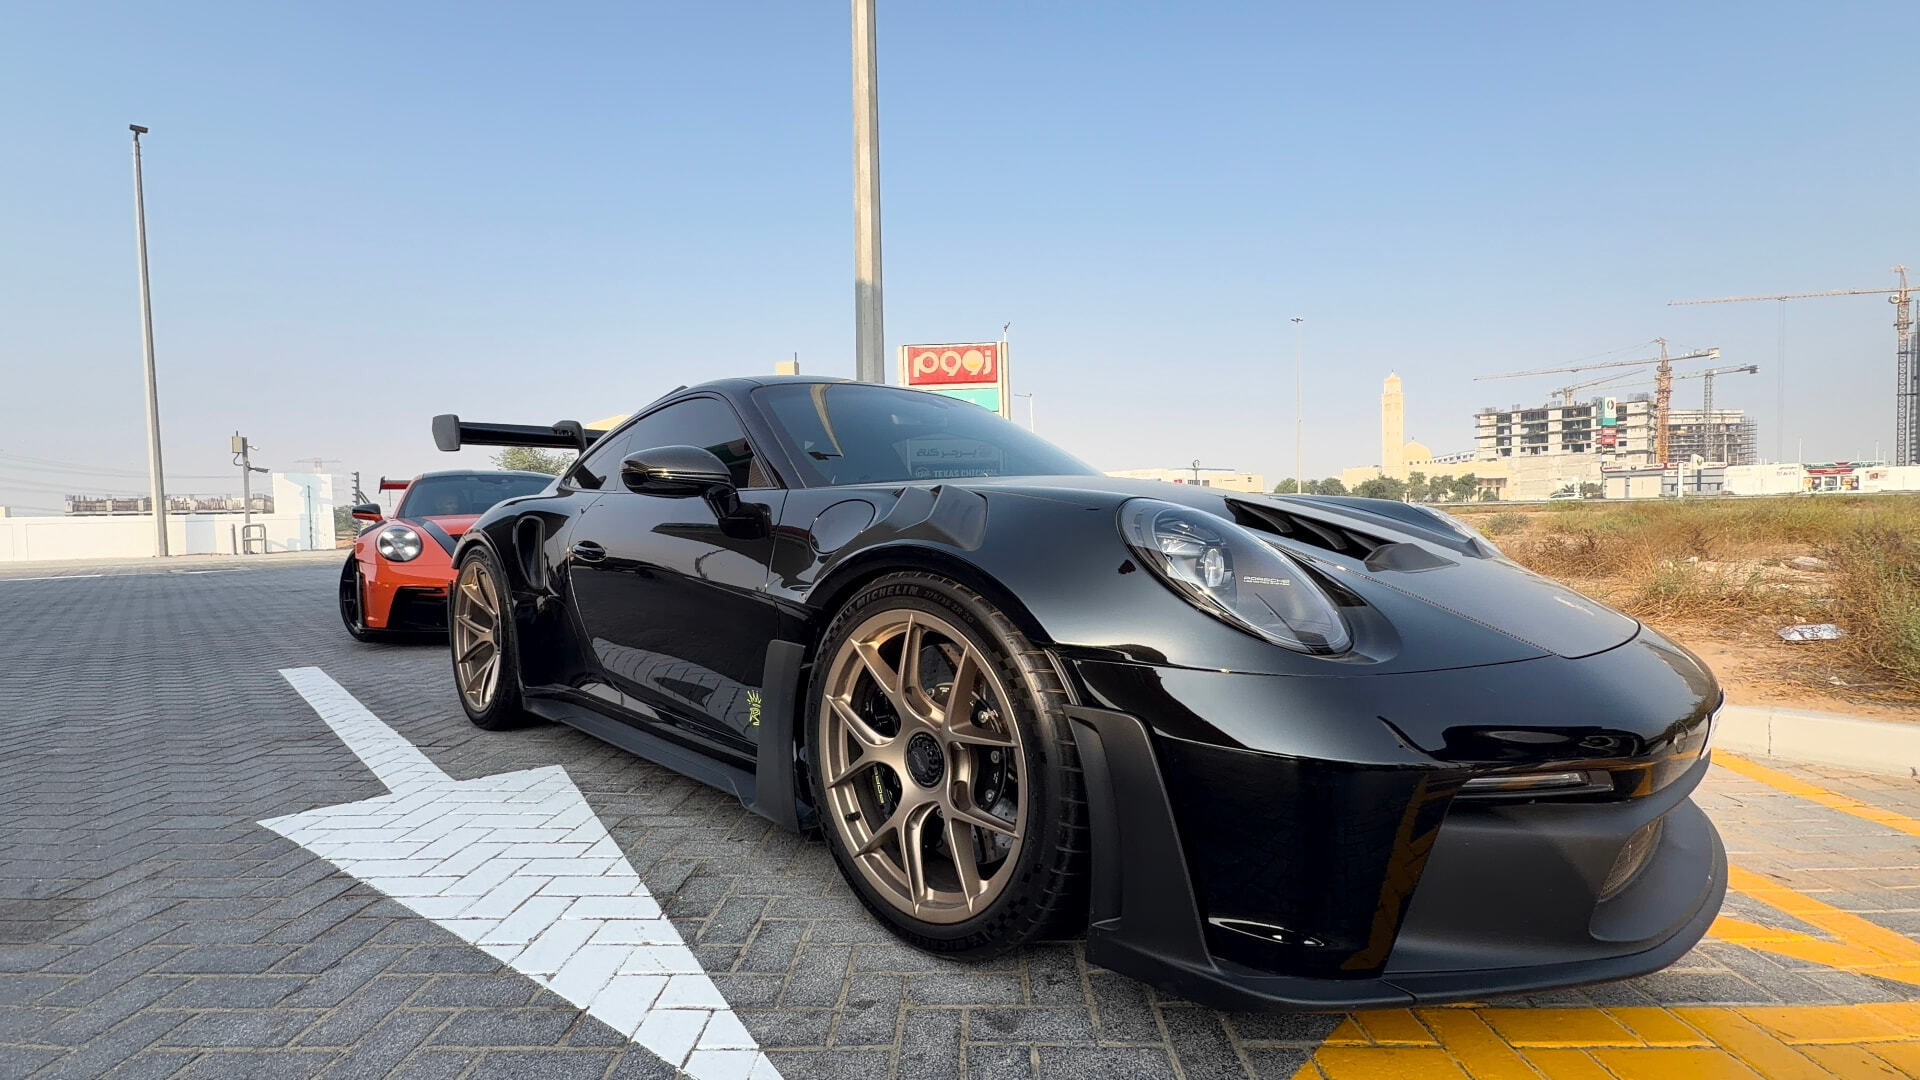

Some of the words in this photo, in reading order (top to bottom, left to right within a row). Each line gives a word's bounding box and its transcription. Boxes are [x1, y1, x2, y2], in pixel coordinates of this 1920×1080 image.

[913, 349, 992, 378] زووم
[933, 469, 959, 478] TEXAS
[856, 585, 918, 608] MICHELIN
